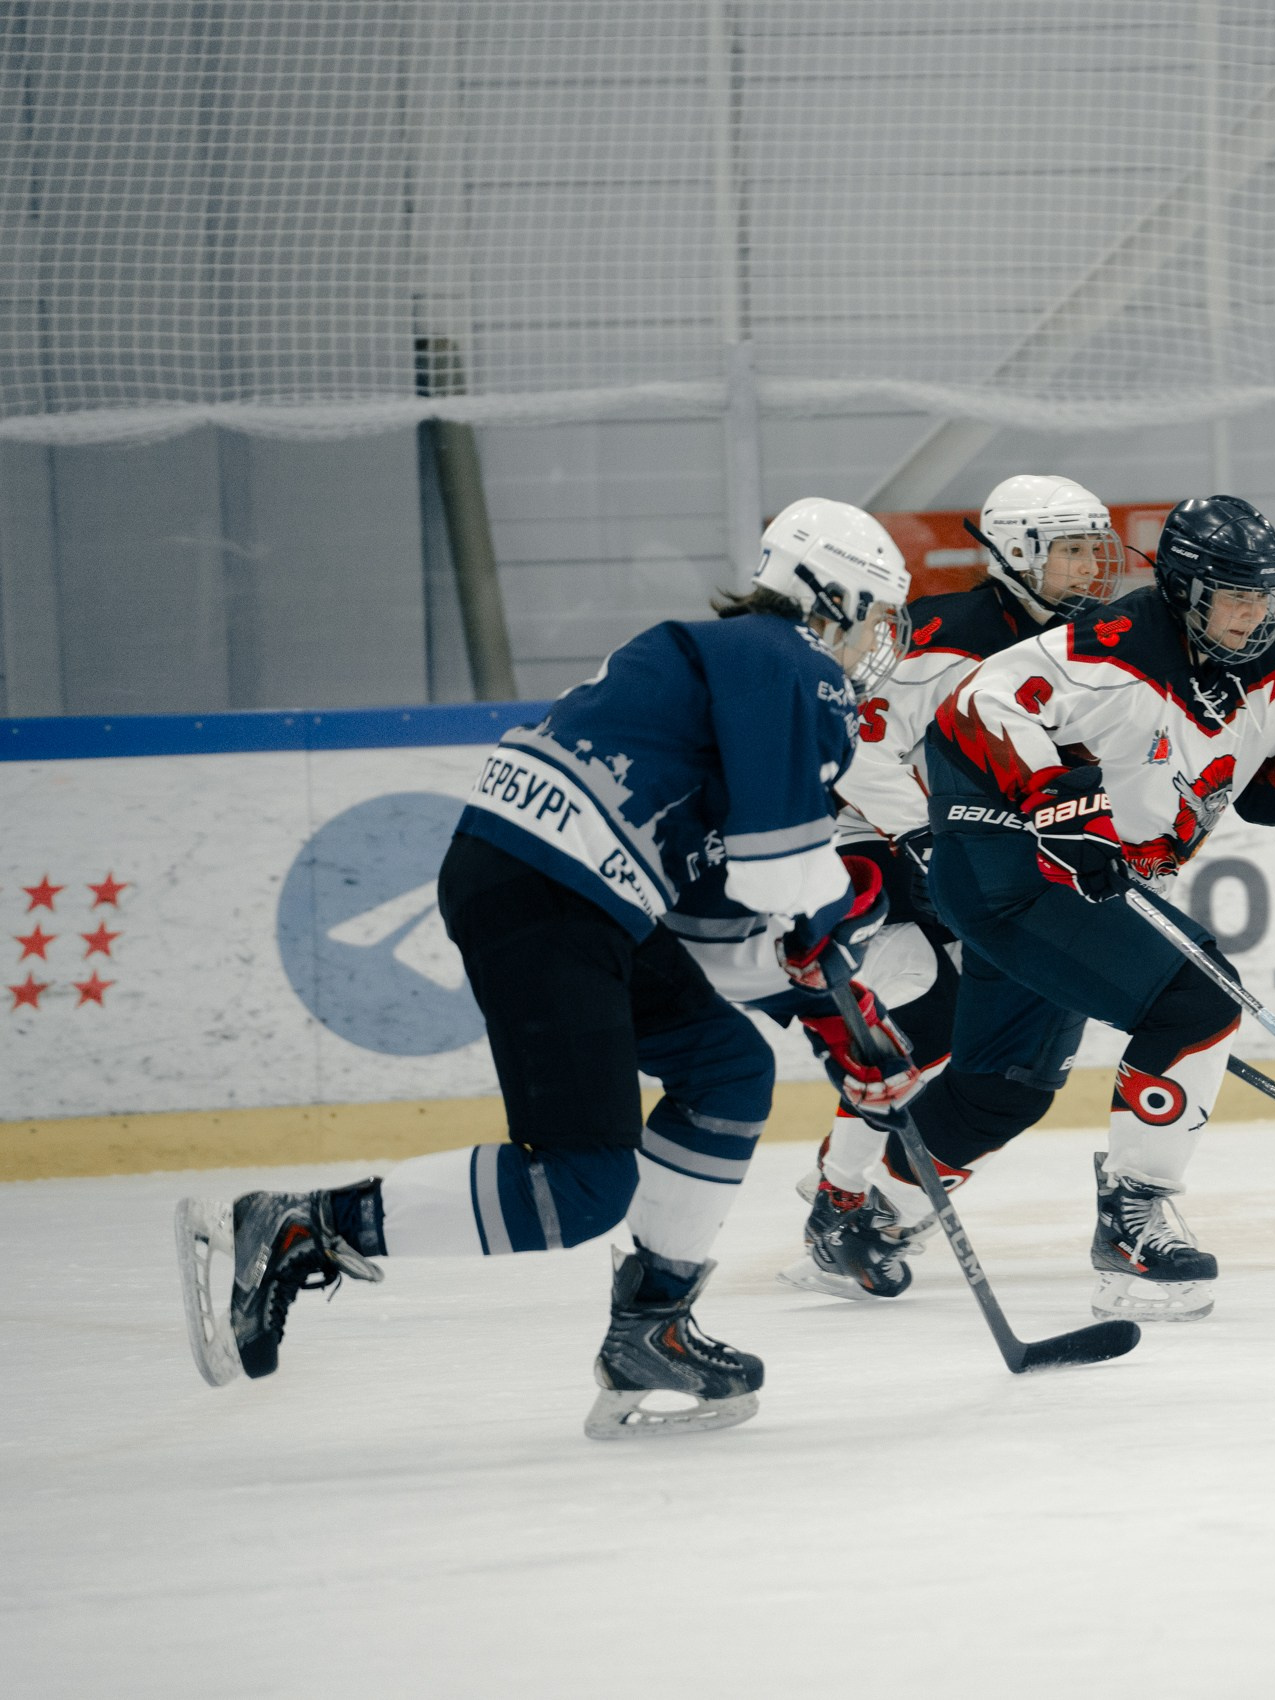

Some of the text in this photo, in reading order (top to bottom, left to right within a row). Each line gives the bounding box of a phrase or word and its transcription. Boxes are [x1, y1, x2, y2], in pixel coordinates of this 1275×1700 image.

[823, 543, 868, 568] BAUER
[1171, 545, 1200, 561] BAUER
[947, 805, 1030, 831] BAUE
[1118, 1241, 1146, 1262] BAUR
